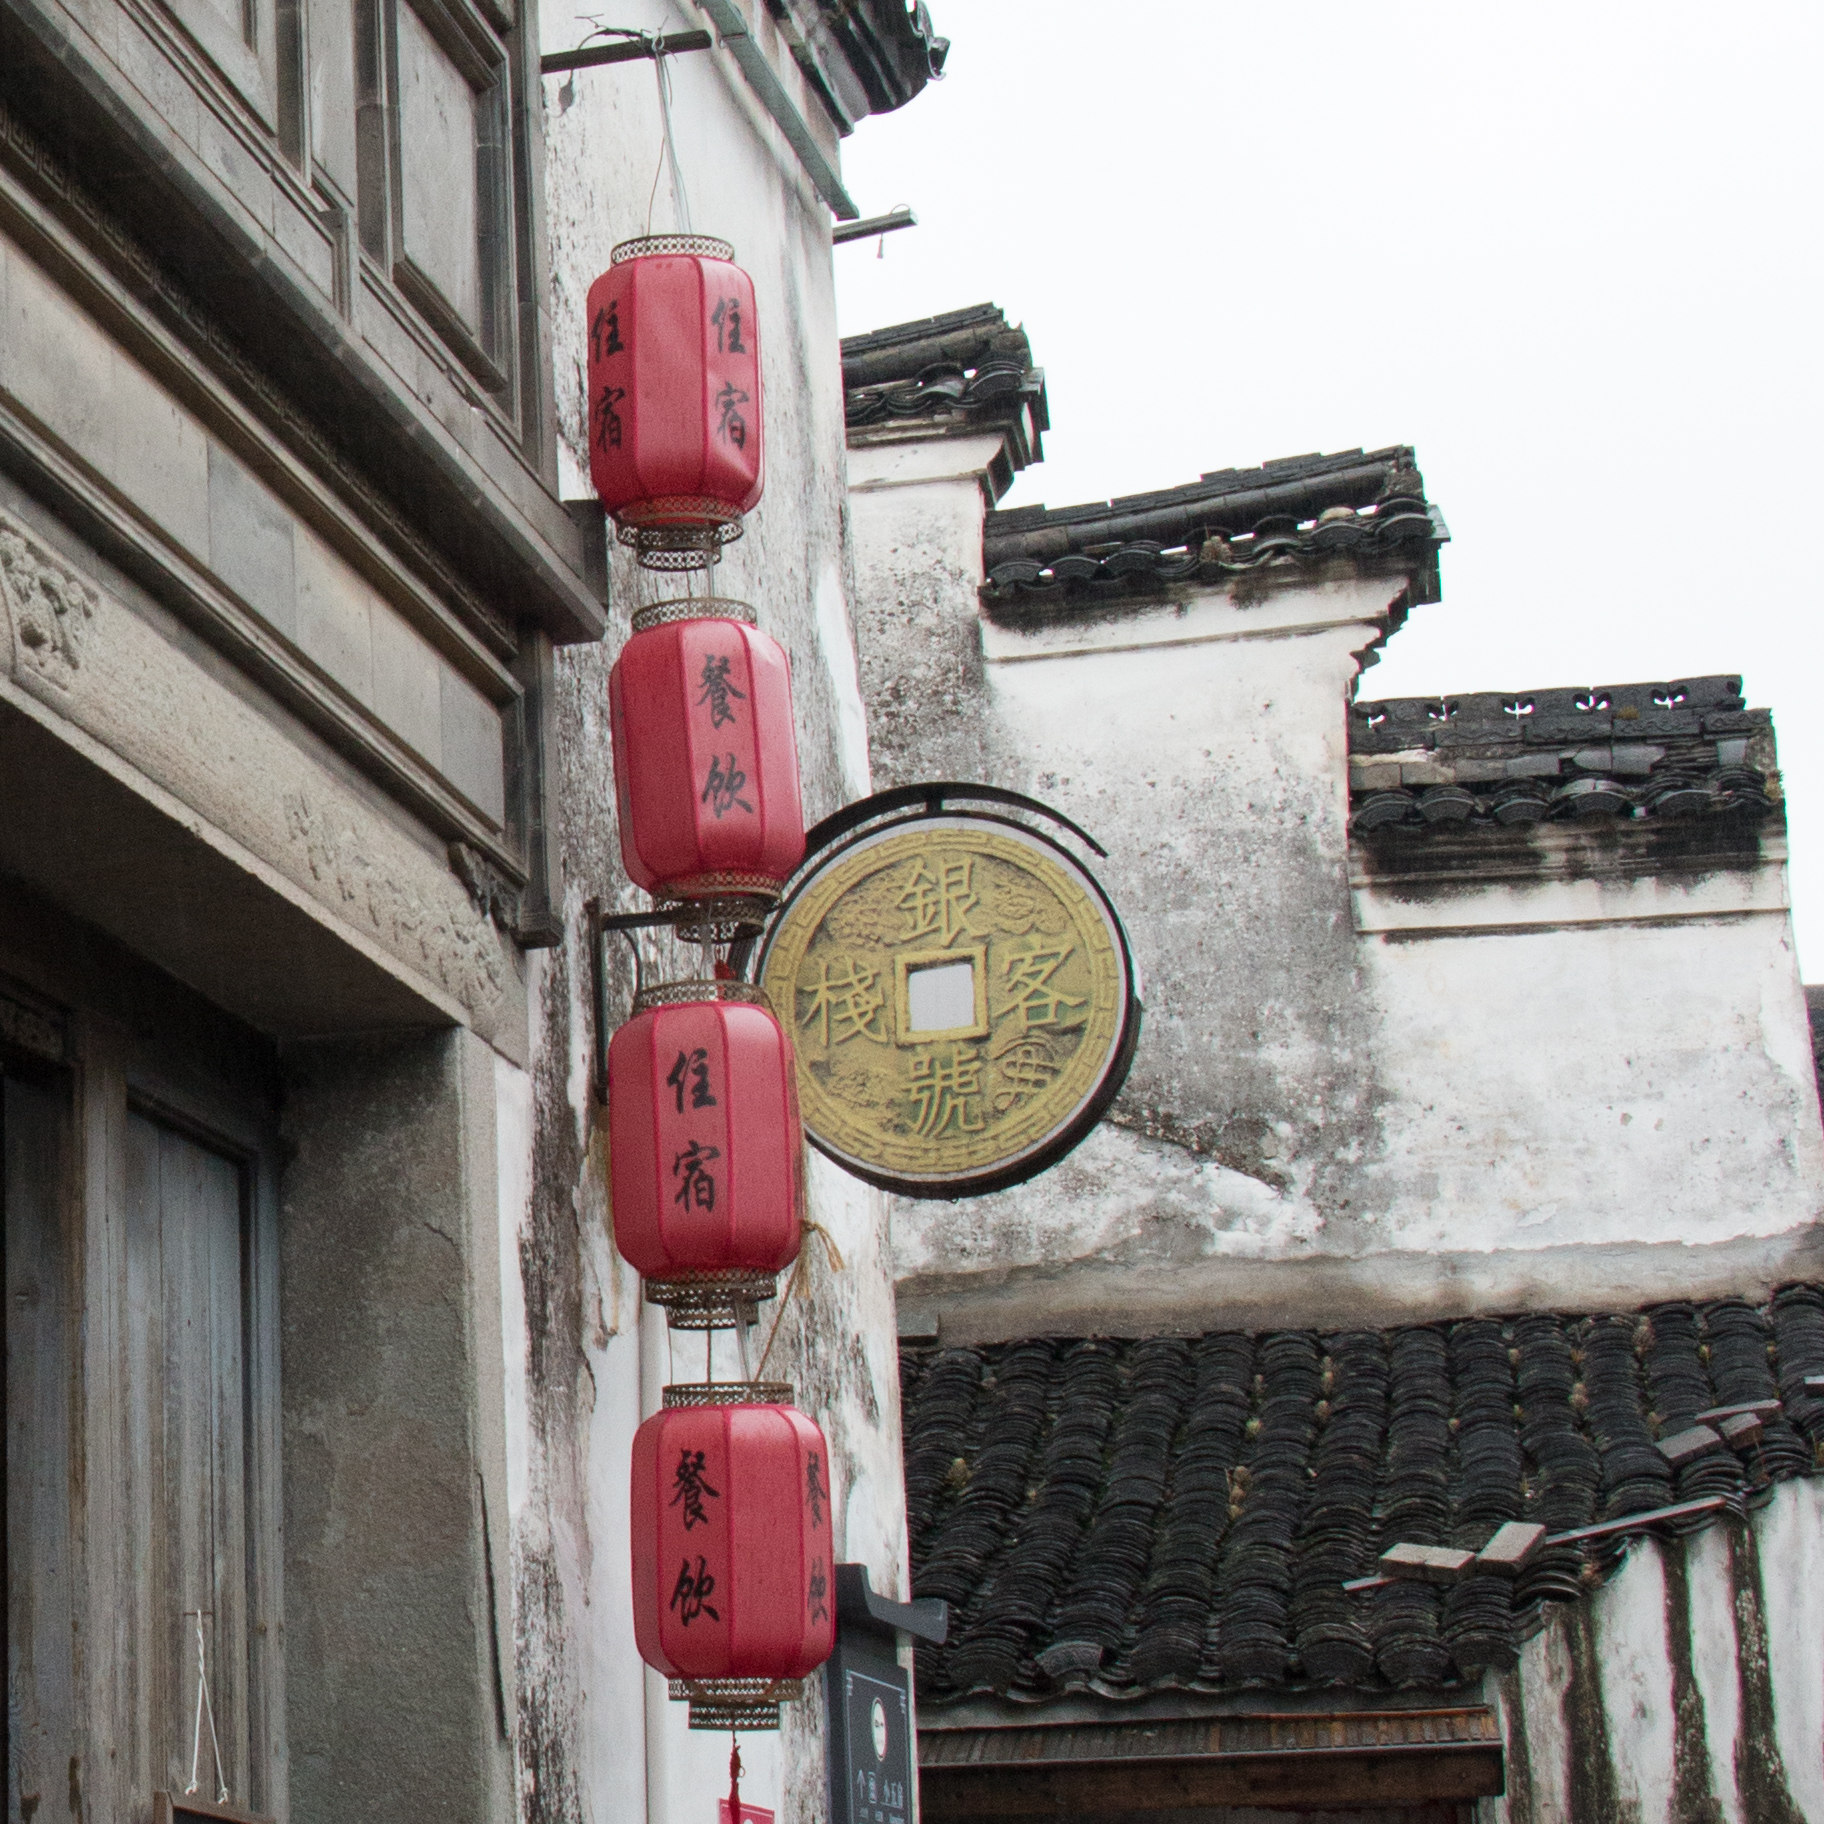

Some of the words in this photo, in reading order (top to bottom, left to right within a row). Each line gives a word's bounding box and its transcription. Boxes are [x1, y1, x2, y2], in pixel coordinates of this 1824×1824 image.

[590, 296, 624, 452] 住宿
[710, 296, 749, 452] 住宿
[695, 652, 754, 820] 餐饮
[666, 1047, 721, 1216] 住宿
[669, 1447, 721, 1629] 餐饮
